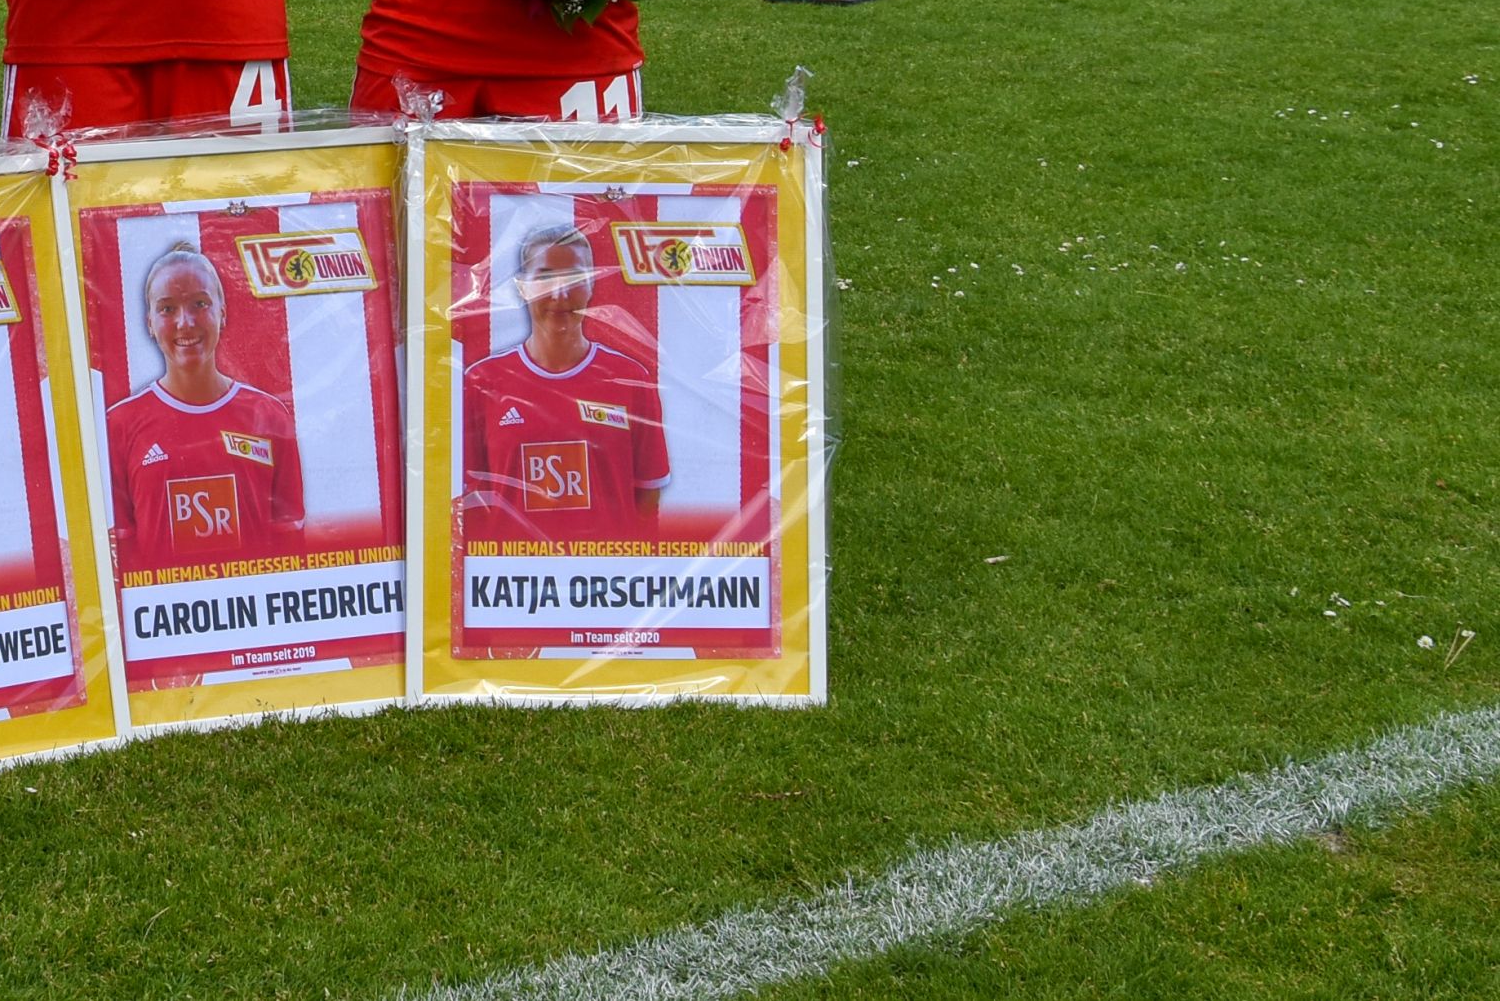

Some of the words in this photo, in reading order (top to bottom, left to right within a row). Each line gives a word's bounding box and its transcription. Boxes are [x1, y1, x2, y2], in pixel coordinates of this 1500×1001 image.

[230, 59, 282, 134] 4
[314, 252, 366, 279] UNION
[691, 247, 746, 271] UNION
[142, 453, 169, 466] adidas
[529, 455, 584, 498] BSR
[175, 492, 233, 537] BSR
[467, 541, 499, 556] UND
[502, 541, 565, 556] NIEMALS
[568, 541, 656, 556] VERGESSEN:
[658, 541, 709, 556] EISERN
[713, 541, 765, 557] UNION!
[123, 570, 153, 587] UND
[156, 563, 218, 584] NIEMALS
[221, 555, 305, 578] VERGESSEN:
[306, 549, 355, 570] EISERN
[13, 586, 61, 609] UNION!
[471, 575, 561, 614] KATJA
[569, 575, 761, 609] ORSCHMANN
[134, 594, 258, 639] CAROLIN
[265, 579, 404, 626] FREDRICH
[571, 631, 583, 643] im
[585, 632, 613, 643] Team
[614, 631, 634, 643] seit
[635, 632, 660, 643] 2020
[231, 653, 244, 666] im
[246, 650, 272, 665] Team
[273, 648, 291, 662] seit
[292, 645, 316, 659] 2019
